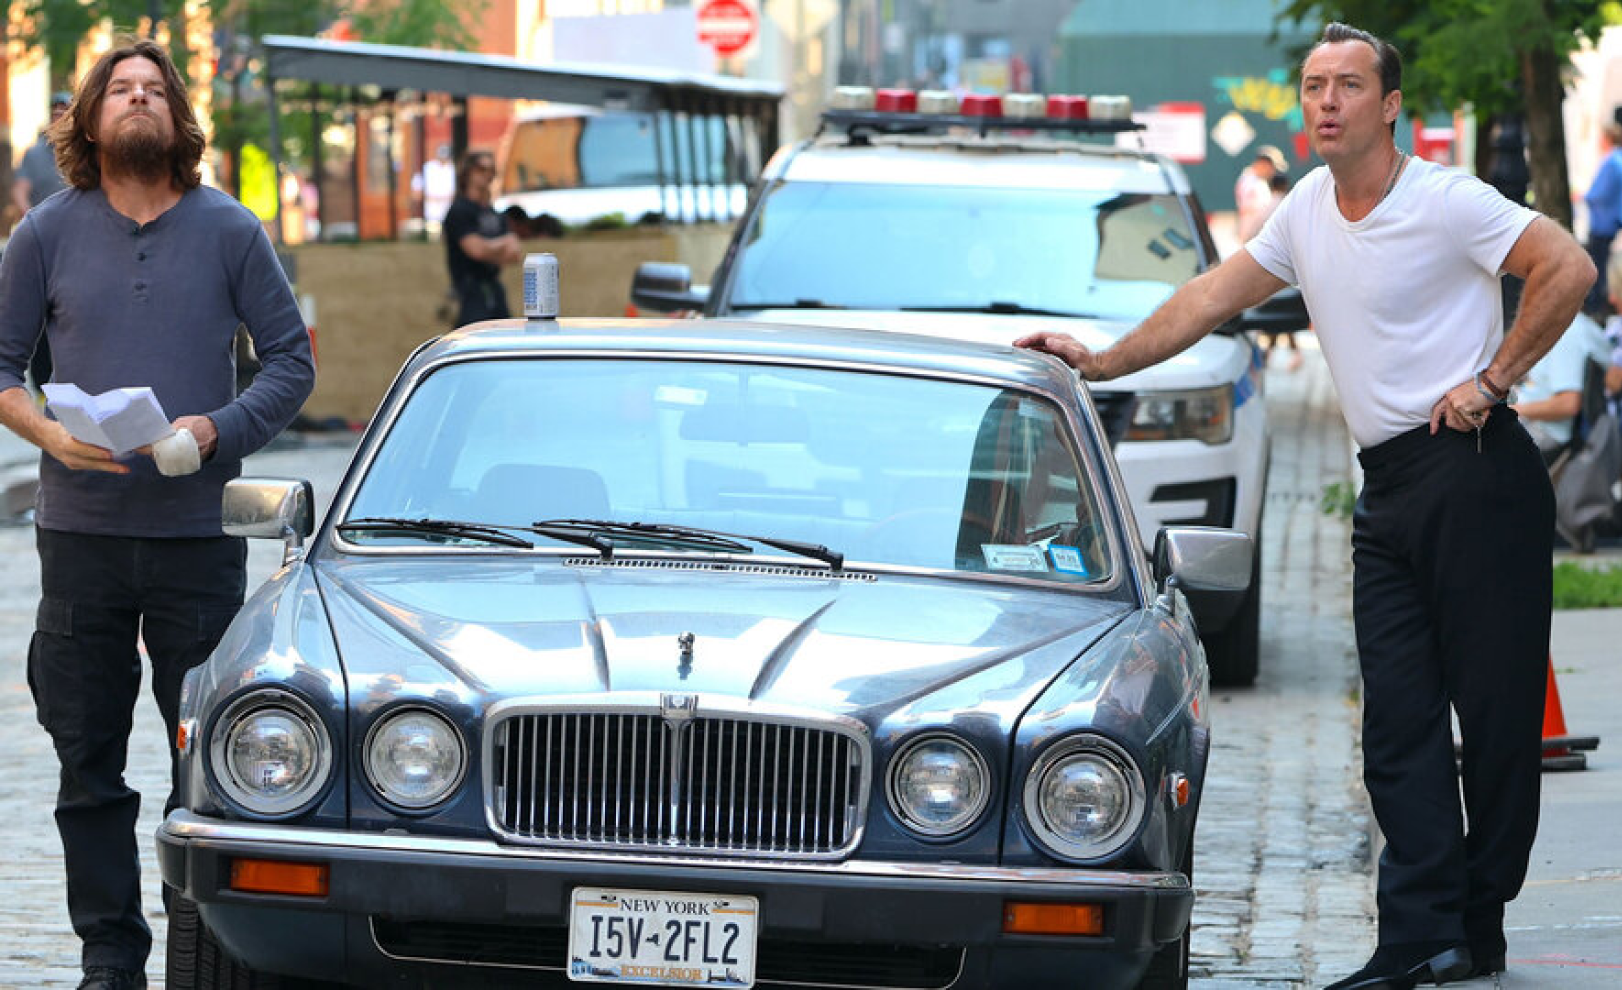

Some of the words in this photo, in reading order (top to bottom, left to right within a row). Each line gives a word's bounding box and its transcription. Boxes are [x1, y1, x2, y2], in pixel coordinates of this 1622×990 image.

[621, 898, 661, 913] NEW
[665, 901, 710, 916] YORK
[663, 919, 741, 965] 2FL2
[619, 965, 703, 981] EXCELSIOR
